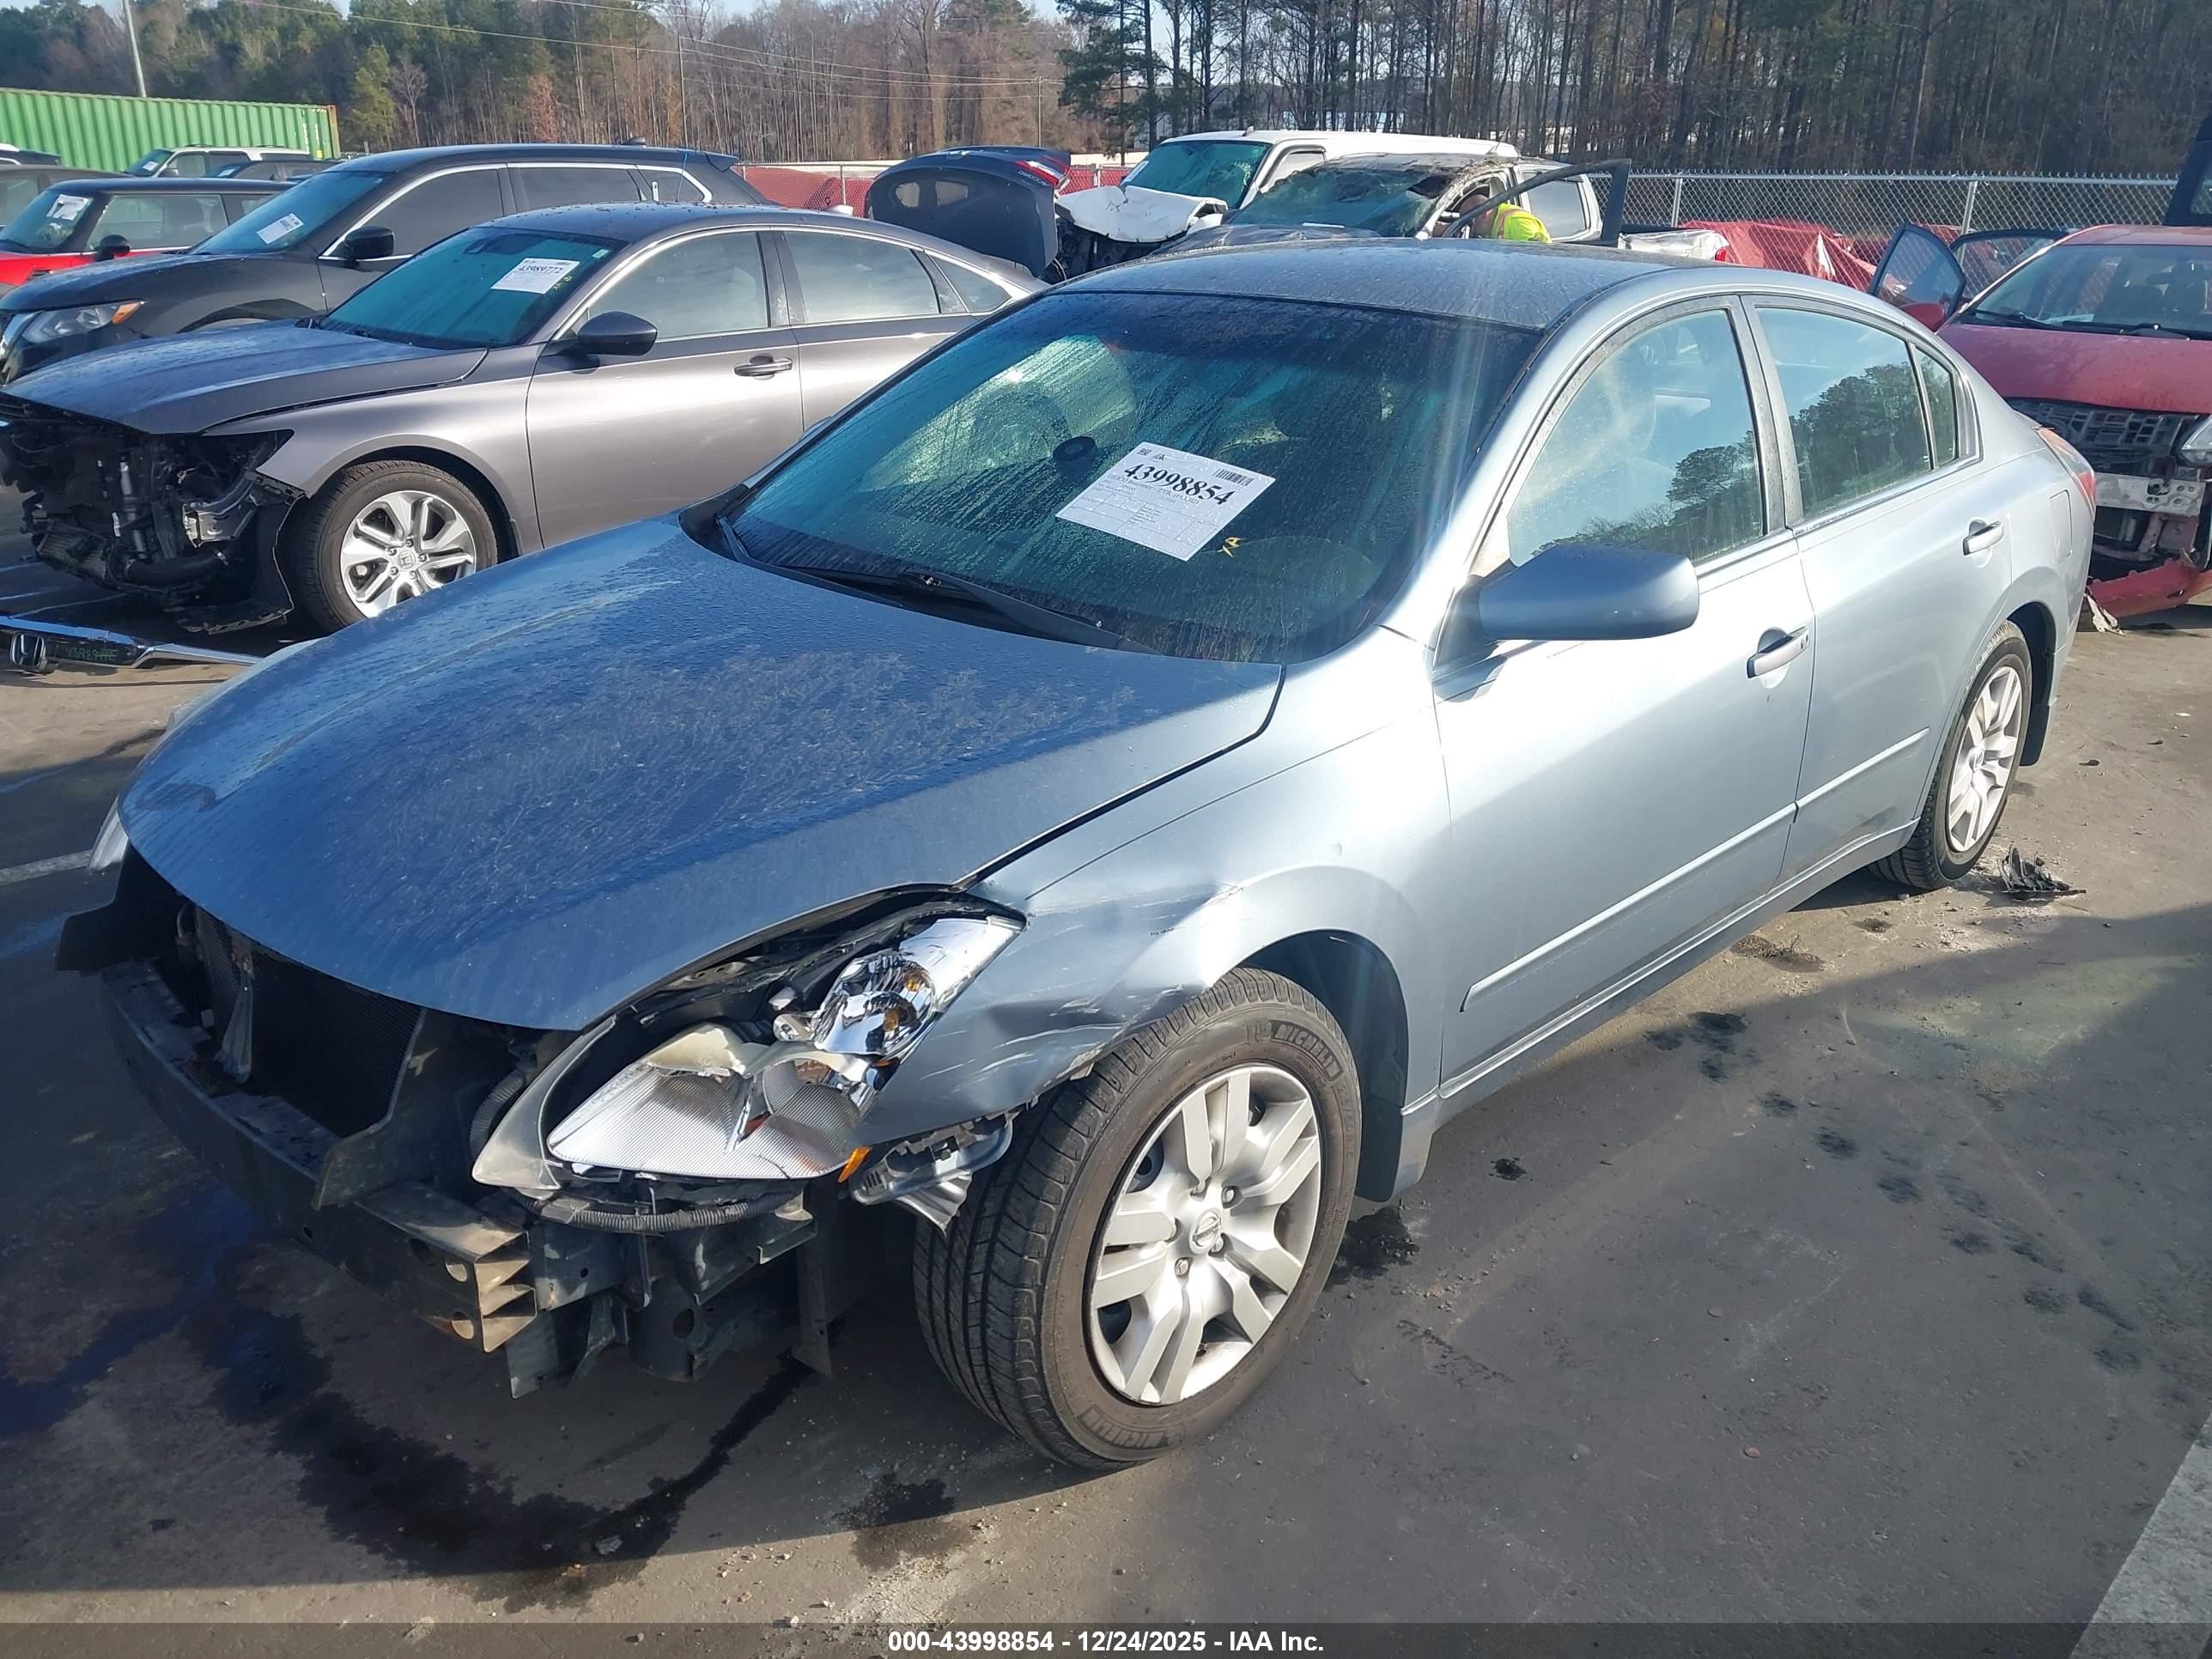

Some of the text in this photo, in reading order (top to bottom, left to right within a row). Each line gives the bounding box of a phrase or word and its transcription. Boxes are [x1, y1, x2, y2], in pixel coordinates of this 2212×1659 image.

[1124, 464, 1236, 505] 43998854
[1274, 1024, 1341, 1078] MICHELIN
[1082, 1408, 1164, 1449] MICHELIN
